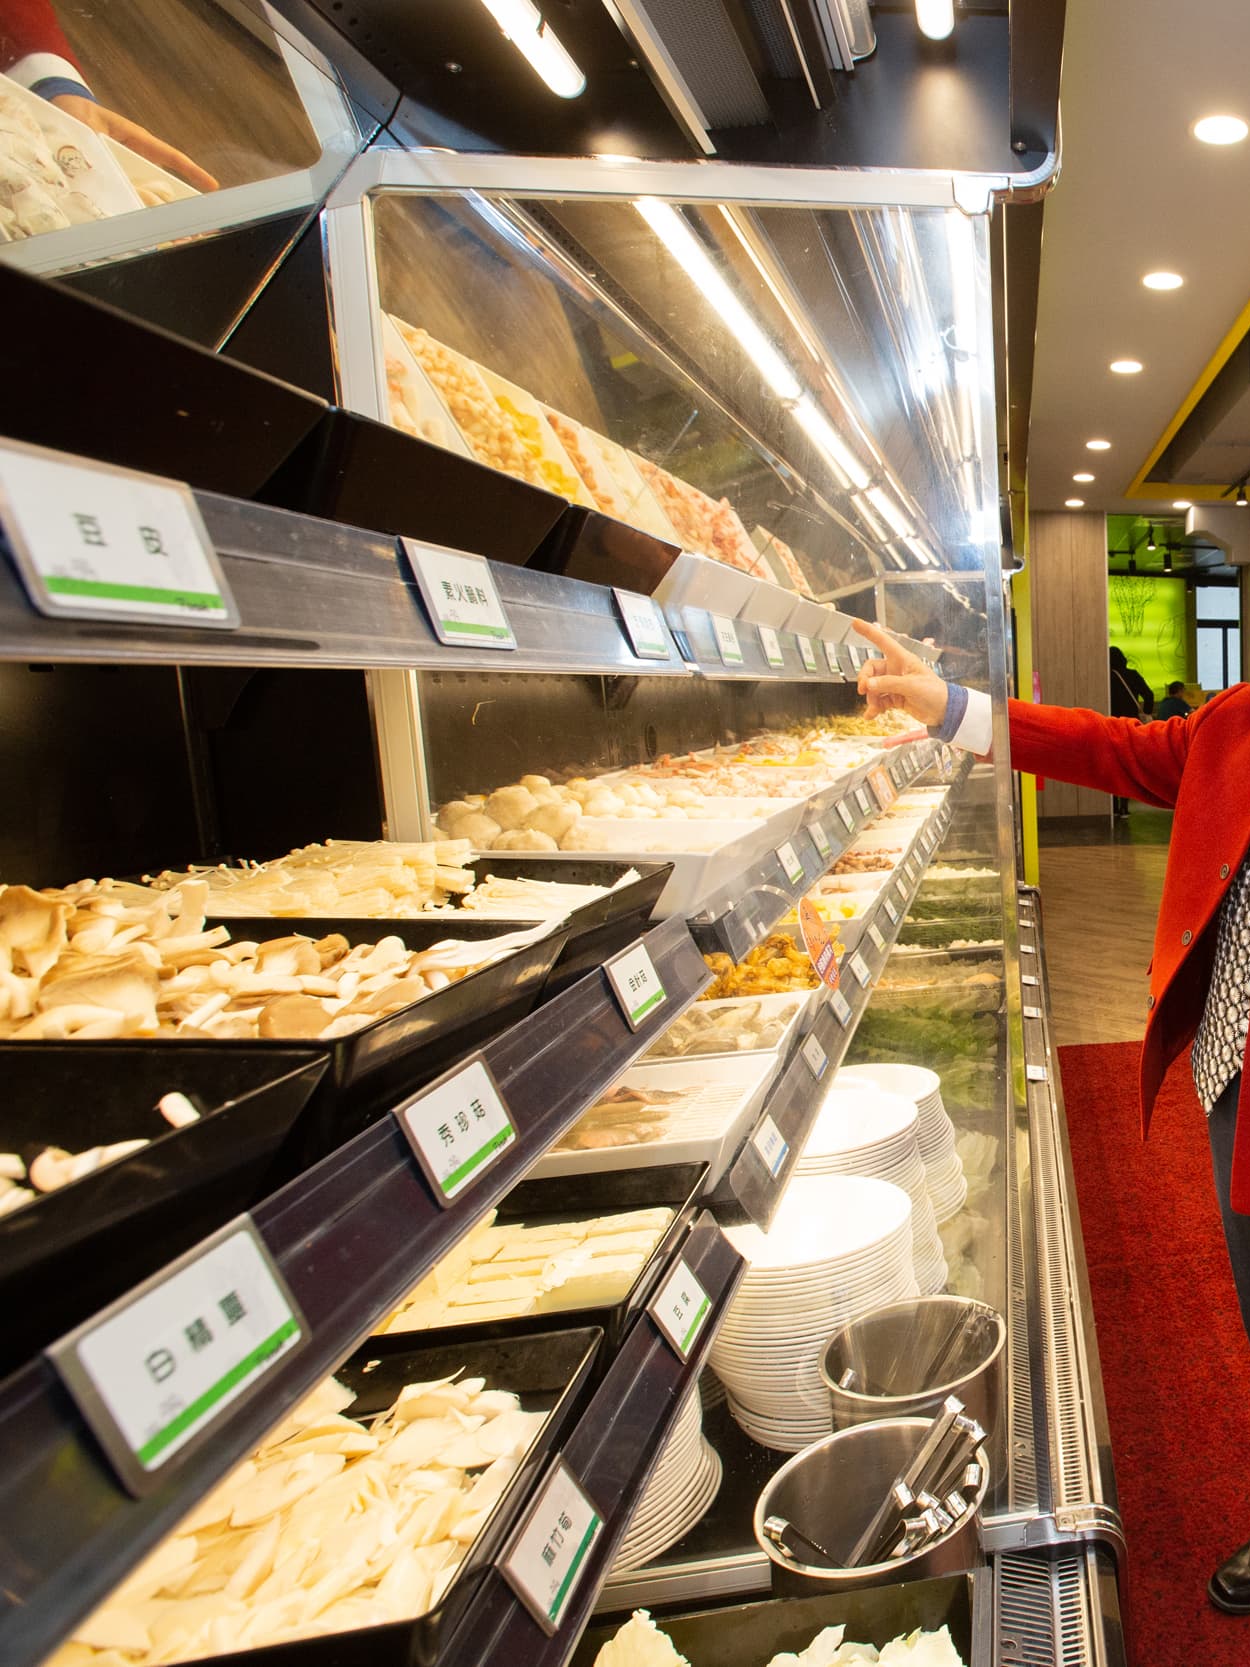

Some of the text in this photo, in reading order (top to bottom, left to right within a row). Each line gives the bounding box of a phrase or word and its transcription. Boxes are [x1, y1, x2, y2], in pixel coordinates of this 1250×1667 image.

[72, 511, 169, 557] 豆皮
[437, 1098, 487, 1148] 秀珍菇
[143, 1289, 248, 1384] 白精靈
